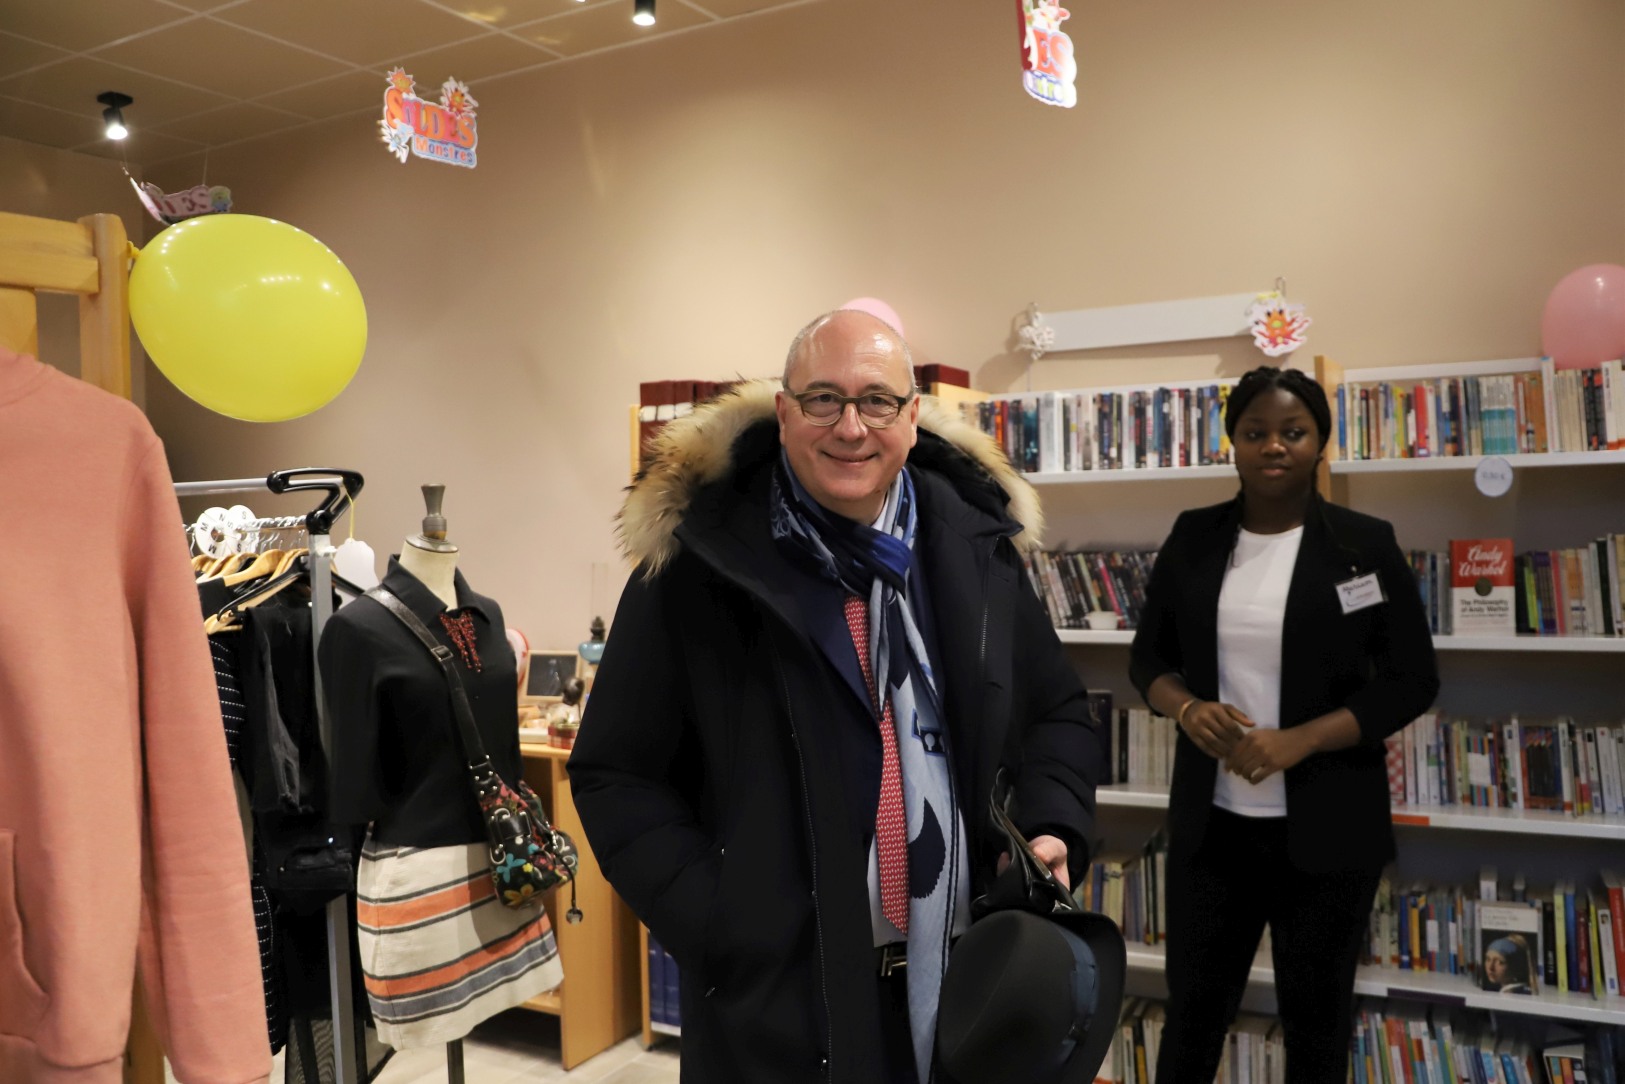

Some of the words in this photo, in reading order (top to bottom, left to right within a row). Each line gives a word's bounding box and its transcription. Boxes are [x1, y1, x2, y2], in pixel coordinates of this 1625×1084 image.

[386, 88, 476, 149] SOLDES
[415, 136, 473, 162] Monstres
[1467, 544, 1504, 562] Andy
